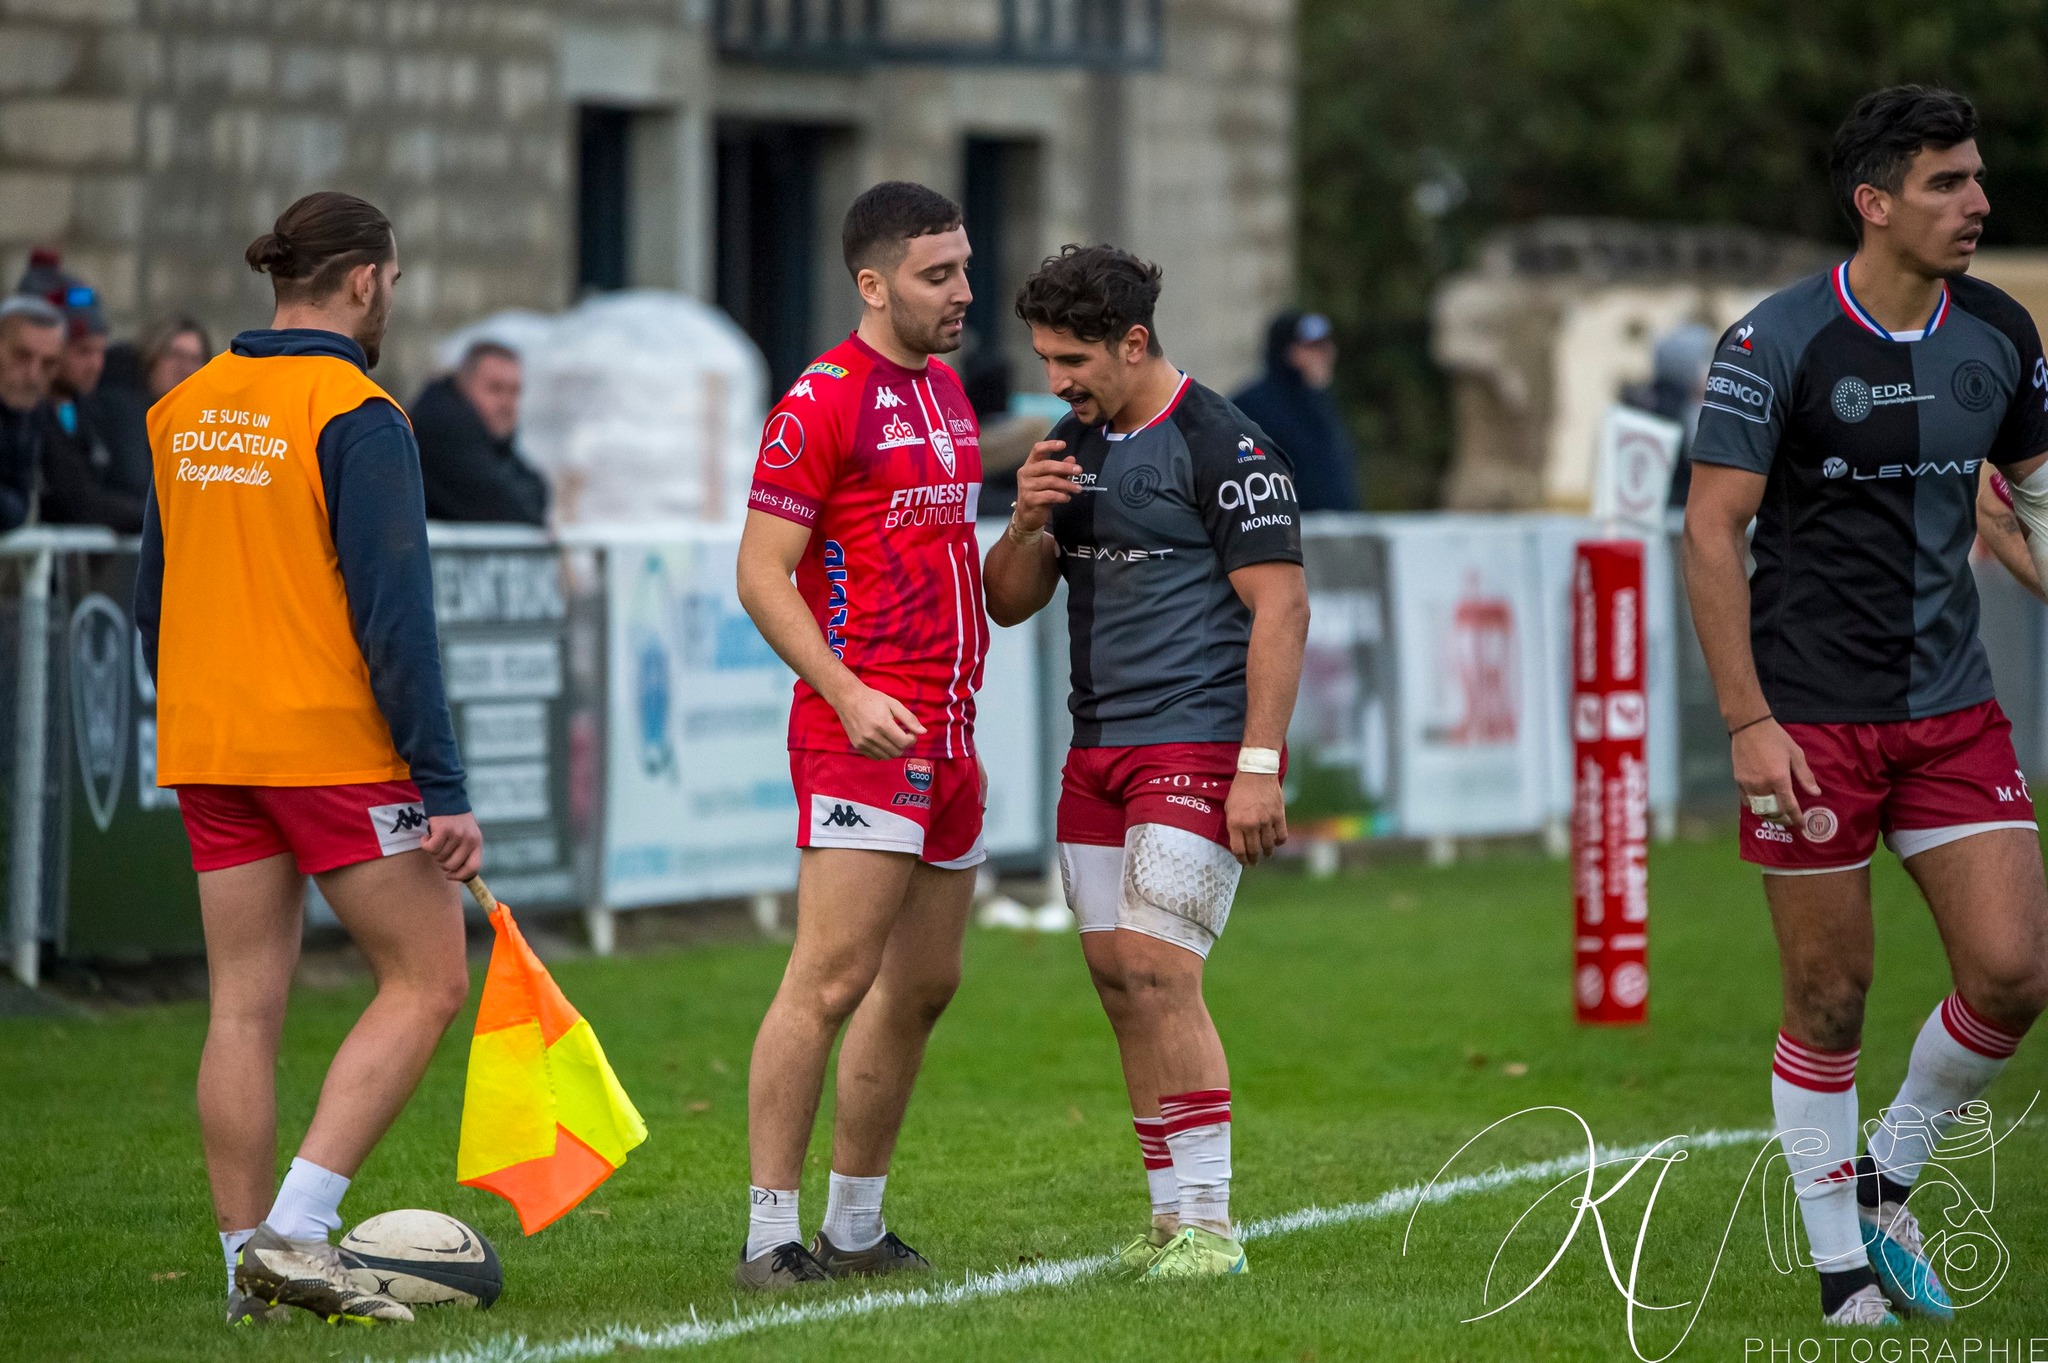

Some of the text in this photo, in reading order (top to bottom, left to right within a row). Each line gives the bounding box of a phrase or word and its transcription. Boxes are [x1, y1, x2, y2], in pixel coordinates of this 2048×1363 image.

[1872, 383, 1912, 399] EDR
[198, 409, 271, 428] JE SUIS UN
[883, 414, 916, 441] sda
[172, 431, 288, 460] EDUCATEUR
[175, 457, 272, 491] Responsible
[1071, 473, 1097, 485] EDR
[1852, 458, 1987, 481] LEVME
[750, 488, 817, 520] edes-Benz
[890, 483, 965, 509] FITNESS
[1218, 472, 1297, 515] apm
[885, 505, 963, 529] BOUTIQUE
[1241, 514, 1292, 533] MONACO
[907, 763, 931, 773] SPORT
[910, 772, 930, 781] 2000
[1166, 794, 1211, 814] adidas
[1755, 828, 1794, 843] adidas
